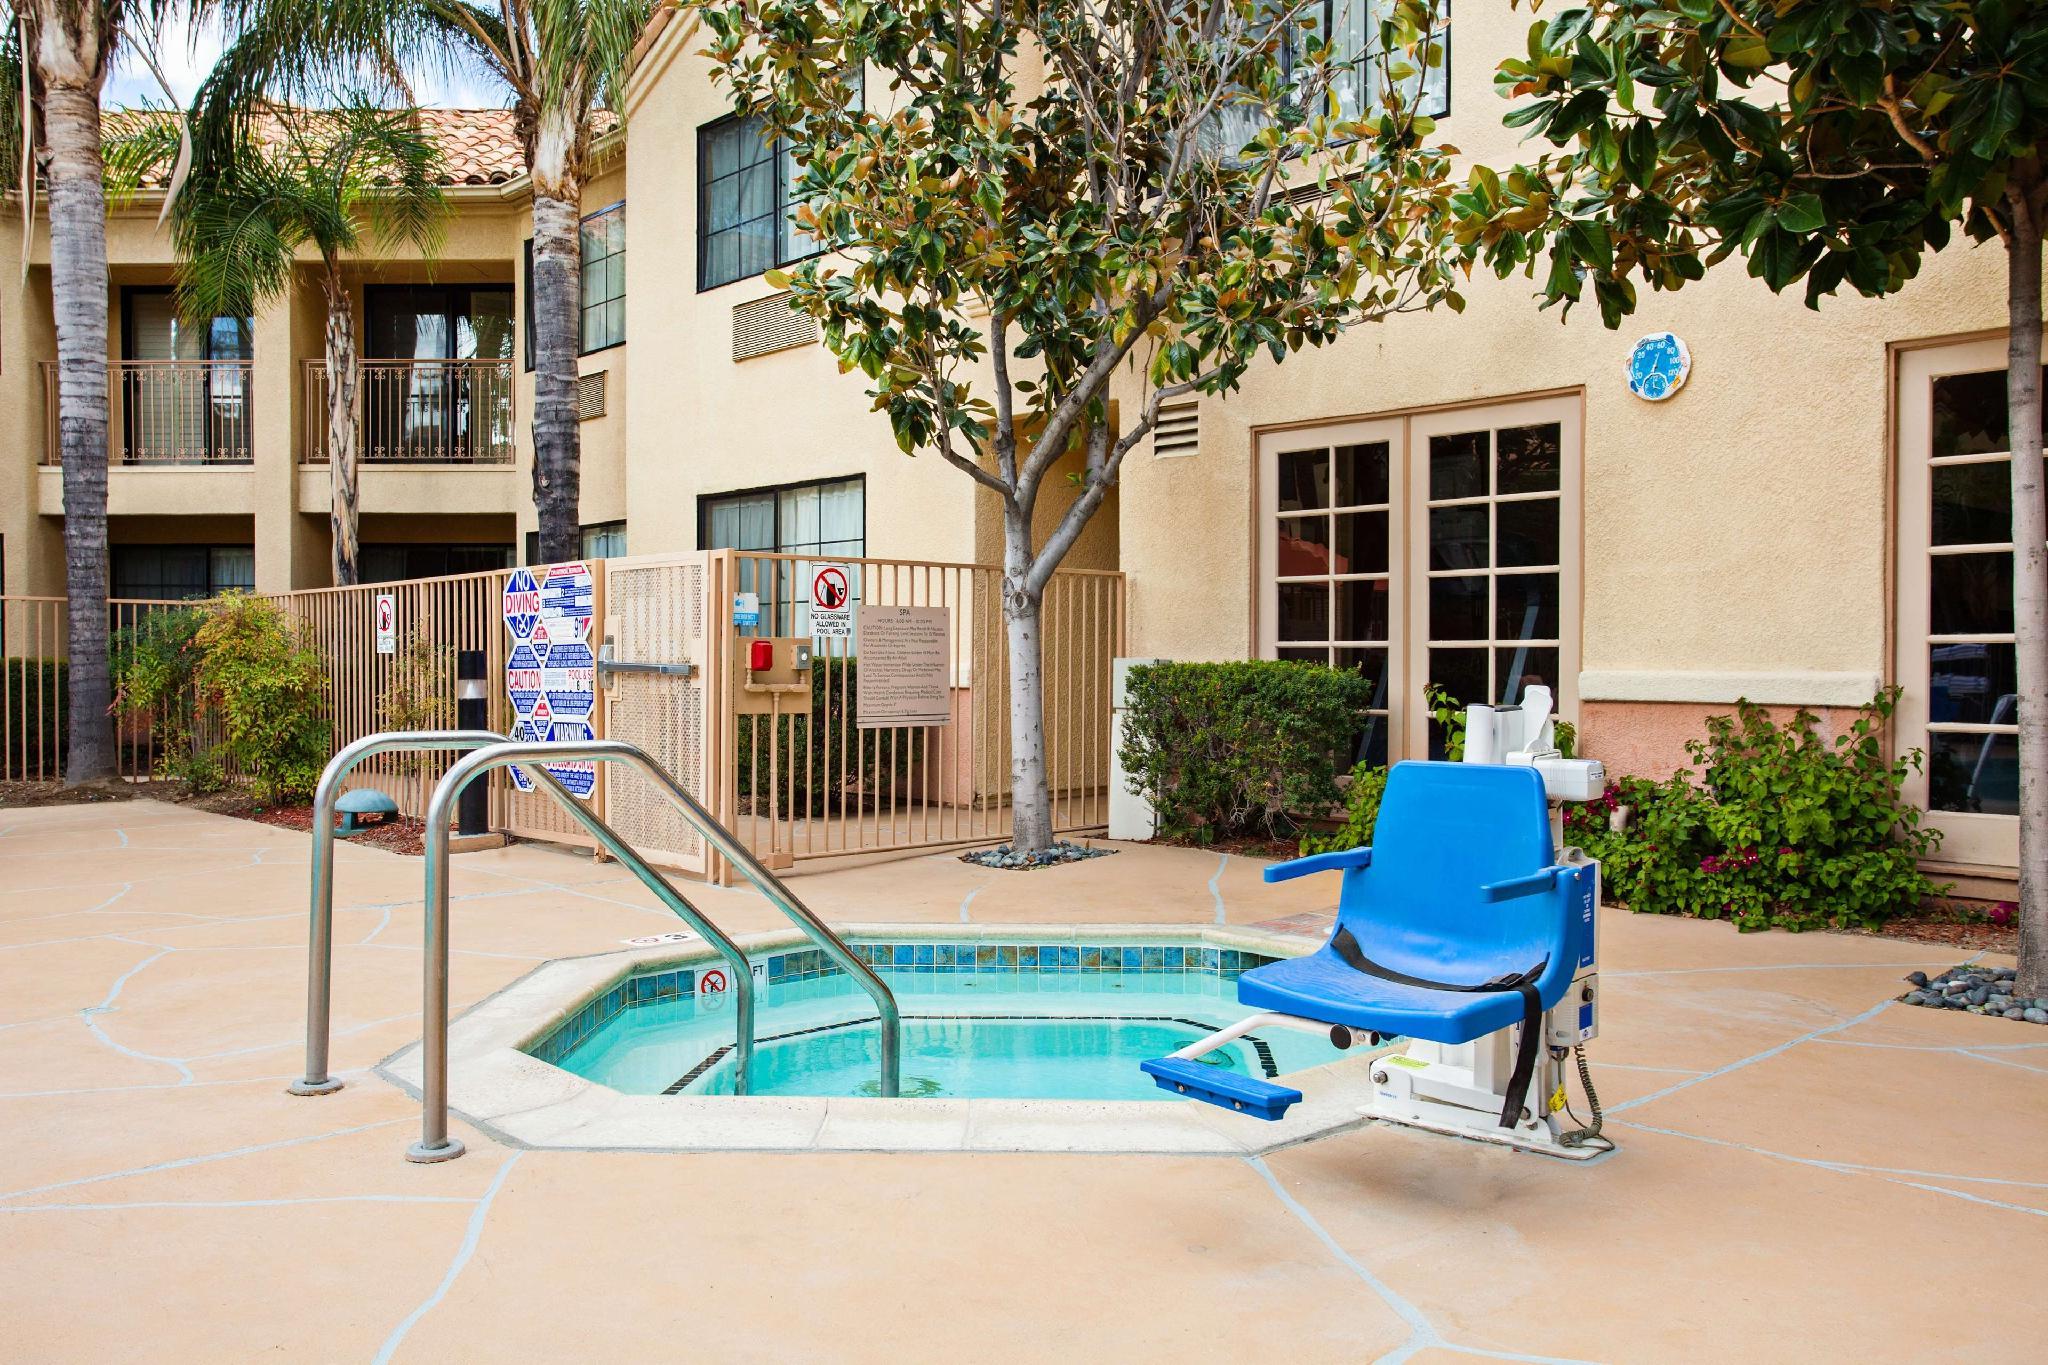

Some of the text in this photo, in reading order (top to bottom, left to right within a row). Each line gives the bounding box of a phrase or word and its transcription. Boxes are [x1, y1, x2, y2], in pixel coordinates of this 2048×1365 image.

[515, 570, 531, 591] NO
[505, 592, 540, 613] DIVING
[574, 617, 584, 638] 911
[508, 670, 541, 689] CAUTION
[514, 727, 525, 742] 40
[553, 723, 588, 741] WARNING
[752, 965, 764, 977] FT
